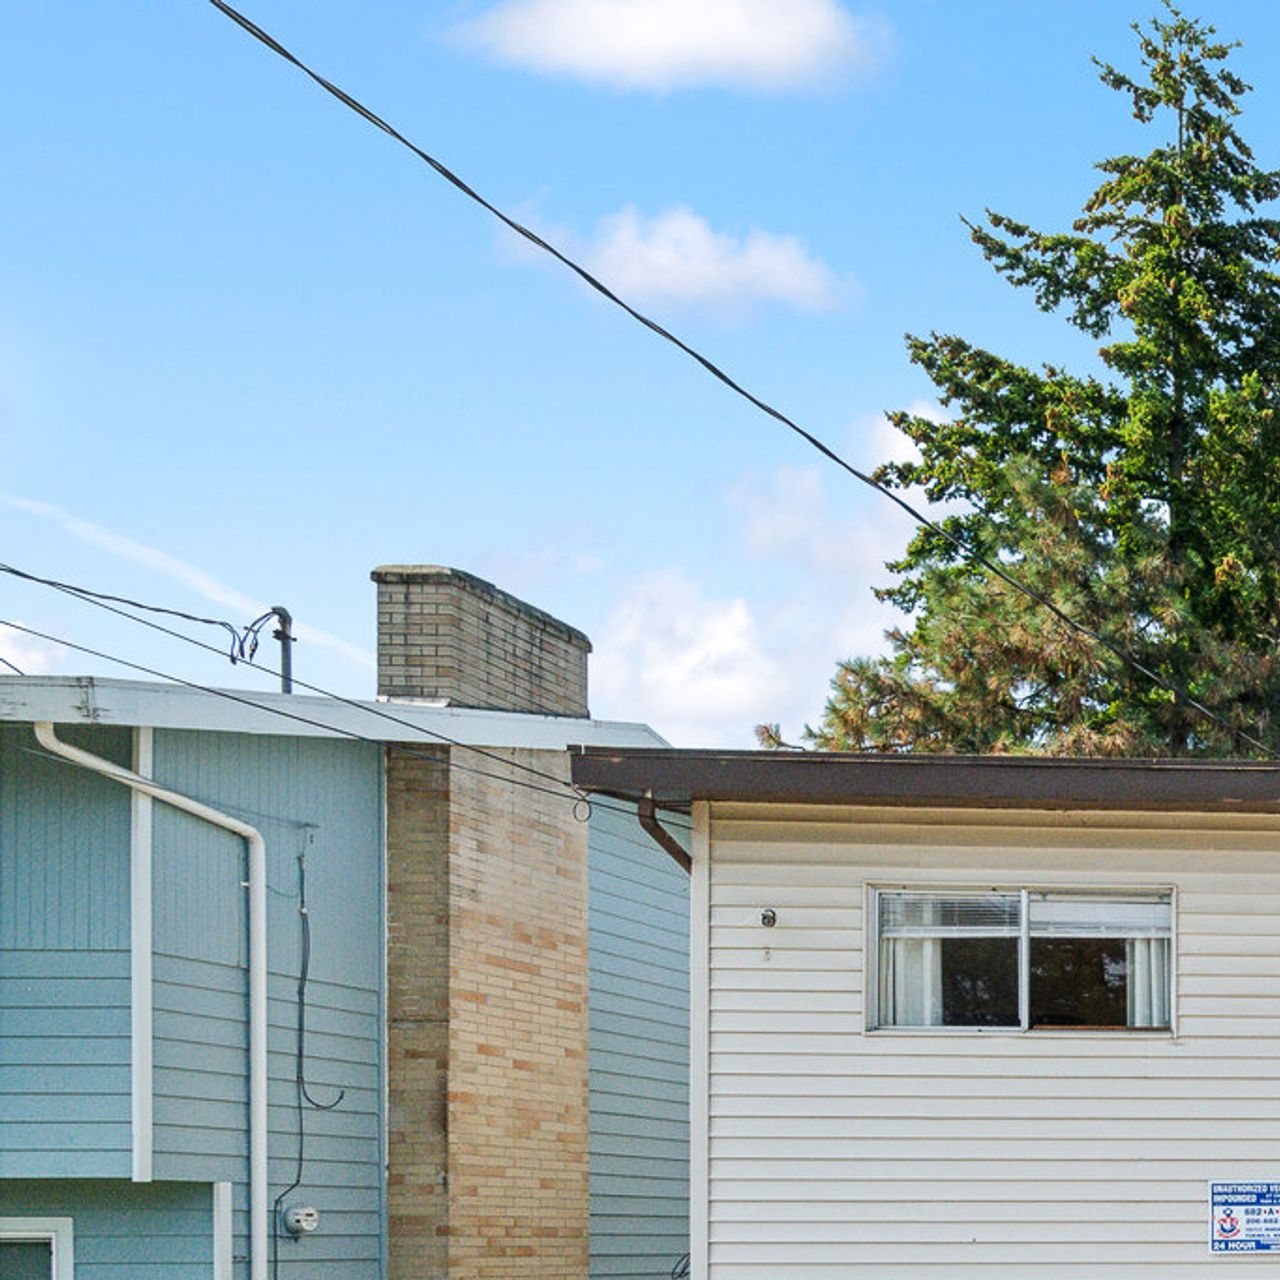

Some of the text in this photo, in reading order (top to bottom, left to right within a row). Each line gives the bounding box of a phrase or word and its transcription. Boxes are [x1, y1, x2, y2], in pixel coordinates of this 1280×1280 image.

[1213, 1185, 1268, 1193] UNAUTHORIZED
[1213, 1194, 1257, 1203] IMPOUNDED
[1213, 1241, 1226, 1250] 24
[1228, 1241, 1256, 1250] HOUR
